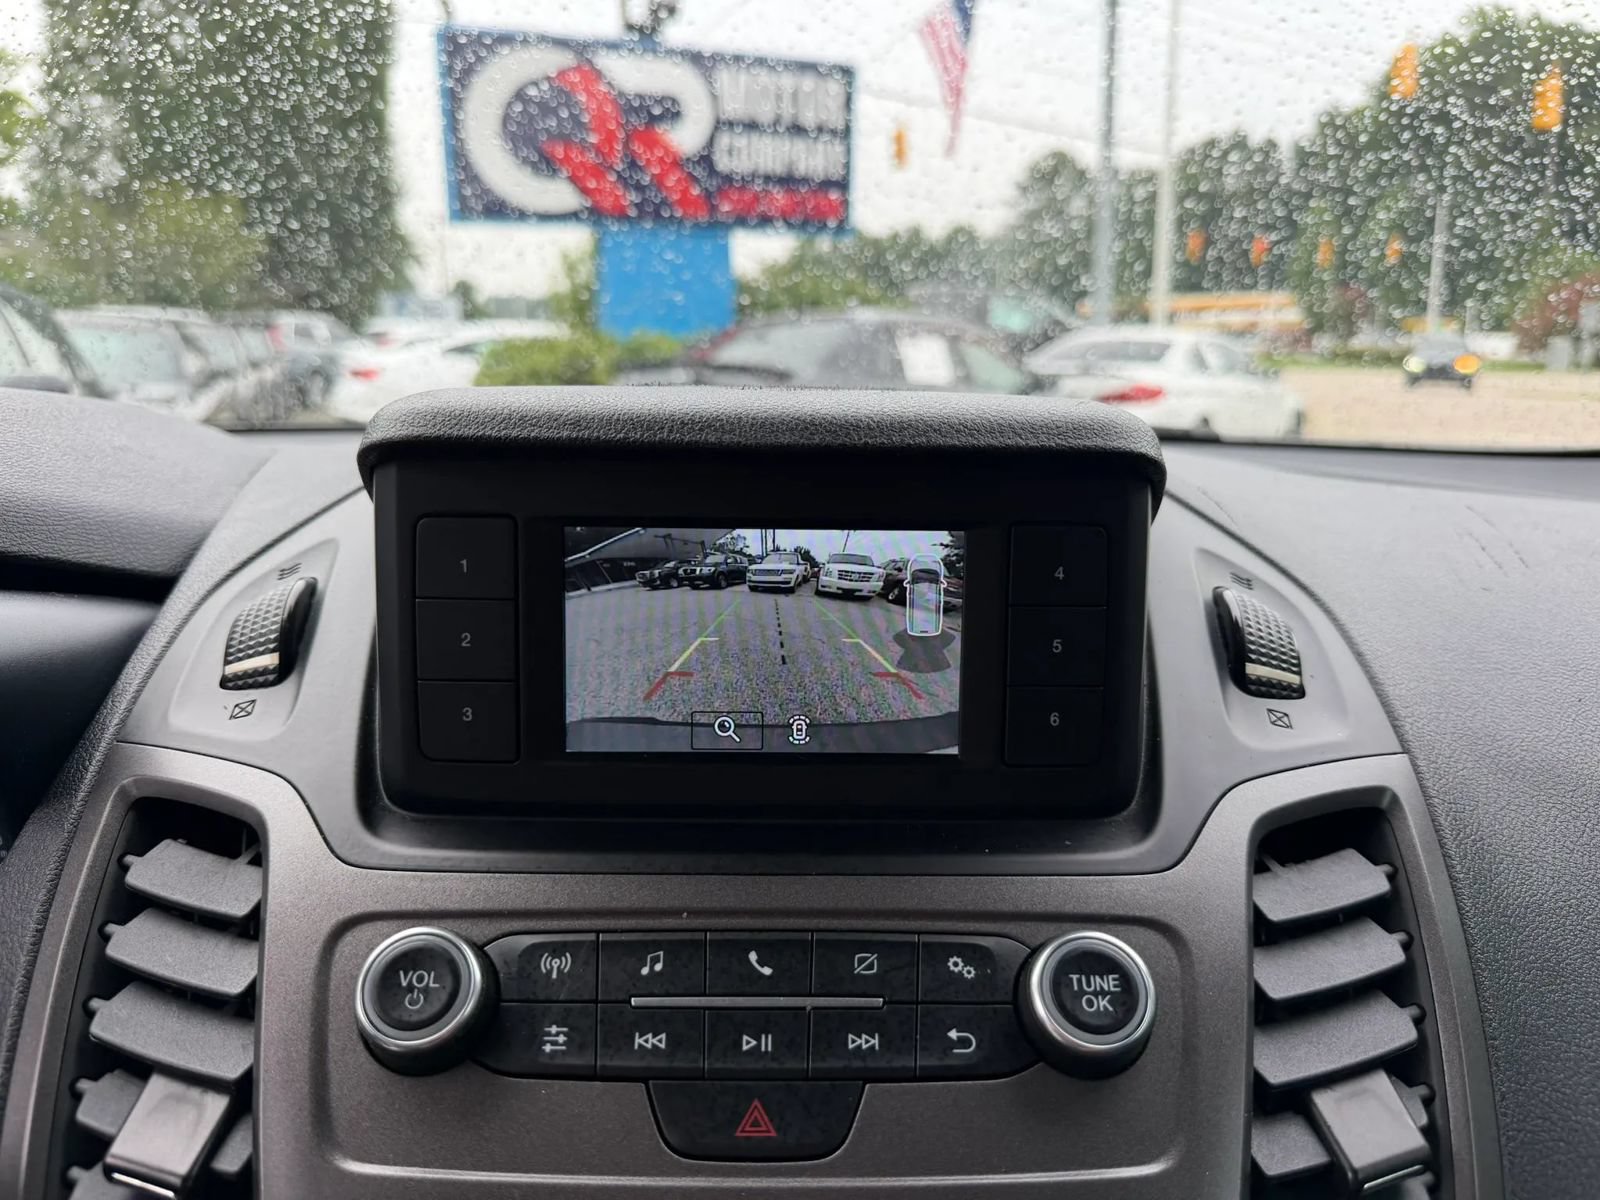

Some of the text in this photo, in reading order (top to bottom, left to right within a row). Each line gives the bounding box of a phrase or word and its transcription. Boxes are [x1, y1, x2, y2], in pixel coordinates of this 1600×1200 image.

[460, 558, 468, 573] 1
[1054, 566, 1065, 580] 4
[461, 632, 471, 647] 2
[1052, 639, 1062, 653] 5
[462, 707, 473, 722] 3
[1049, 712, 1060, 726] 6
[399, 970, 440, 987] VOL
[1068, 974, 1121, 991] TUNE
[1081, 994, 1114, 1012] OK
